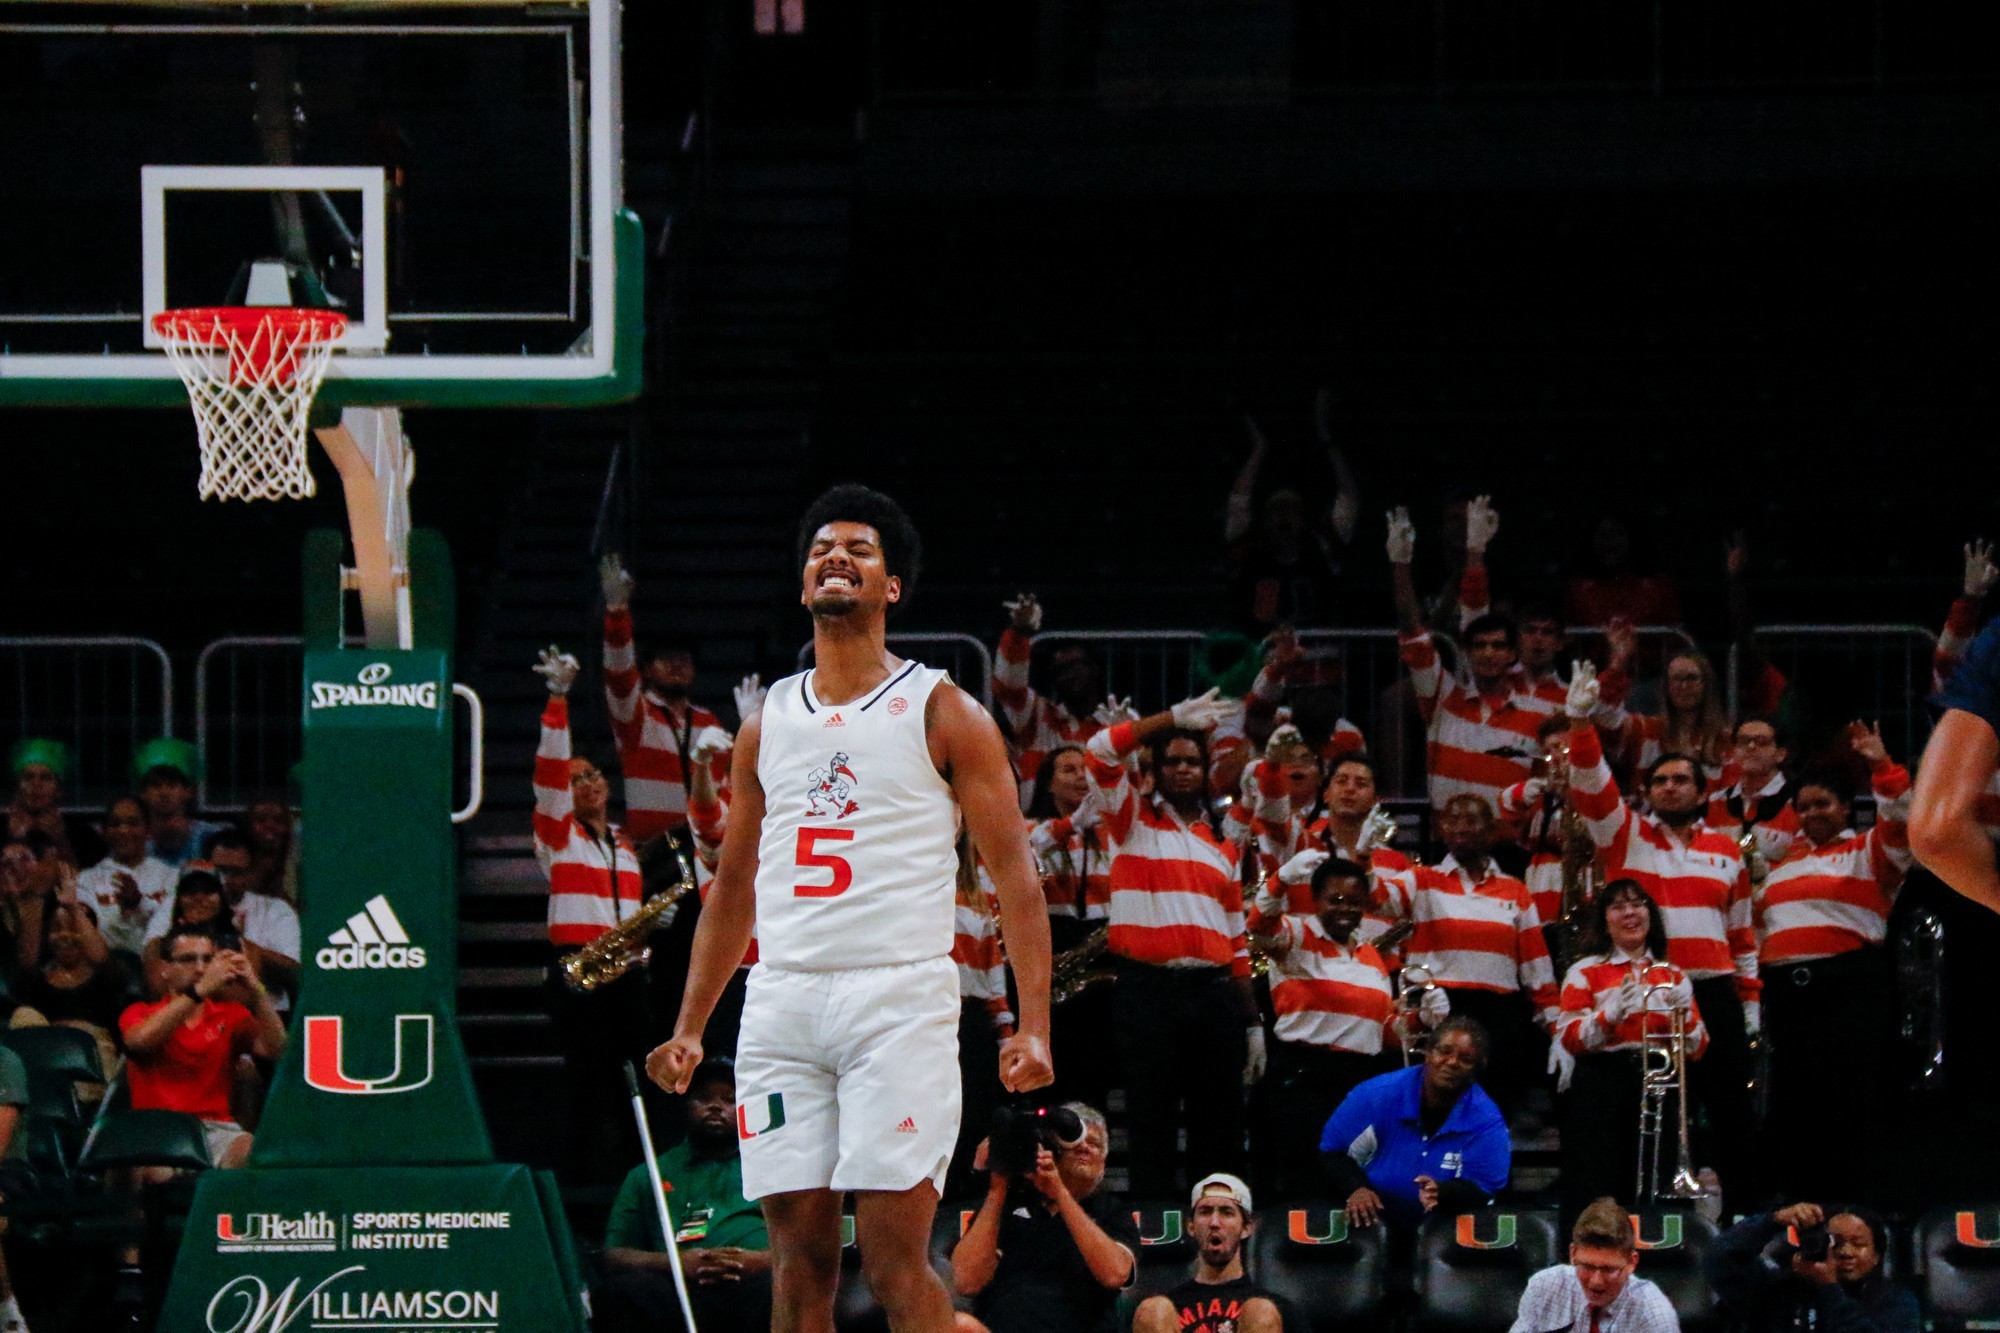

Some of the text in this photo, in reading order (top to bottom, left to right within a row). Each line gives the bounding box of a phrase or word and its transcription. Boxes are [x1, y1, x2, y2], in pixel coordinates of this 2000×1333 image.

[311, 682, 436, 708] SPALDING
[794, 827, 855, 898] 5
[316, 942, 426, 969] adidas
[304, 1014, 434, 1095] U
[738, 1092, 786, 1140] U
[217, 1211, 336, 1241] UHealth
[353, 1212, 511, 1229] SPORTS MEDICINE
[1288, 1210, 1348, 1245] U
[1456, 1214, 1517, 1248] U
[351, 1233, 450, 1249] INSTITUTE
[206, 1265, 498, 1333] WILLIAMSON
[1178, 1297, 1242, 1330] MIAM
